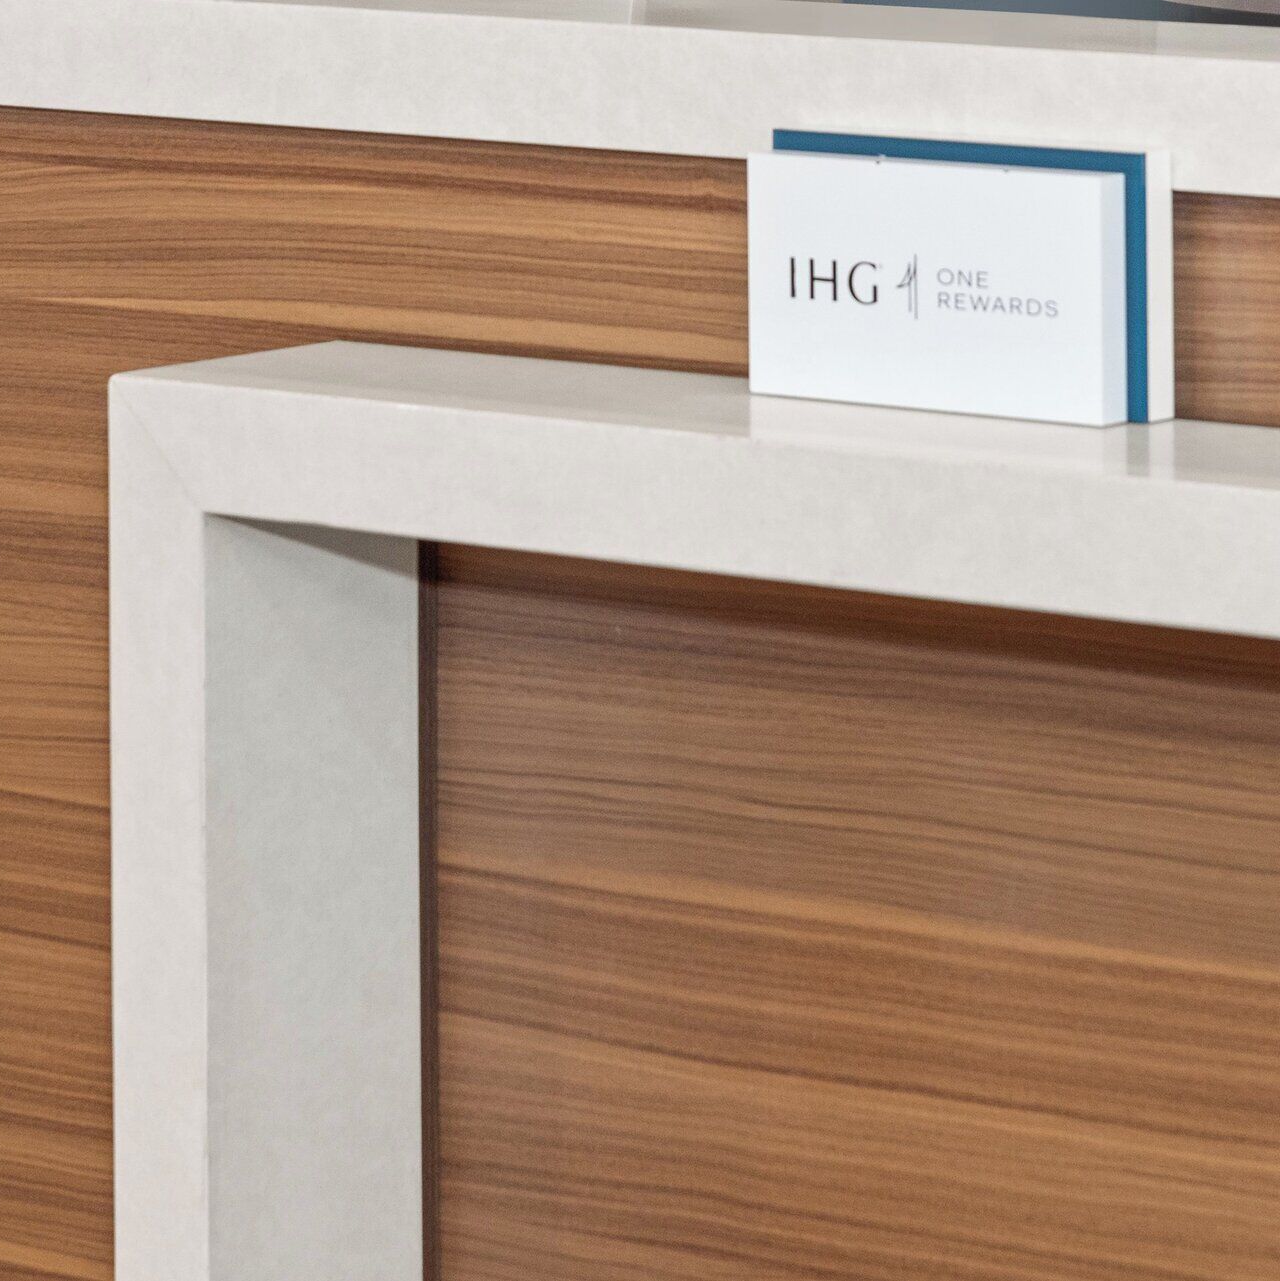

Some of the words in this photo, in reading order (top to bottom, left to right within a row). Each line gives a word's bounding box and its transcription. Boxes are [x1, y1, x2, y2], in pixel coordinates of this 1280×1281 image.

[789, 256, 879, 305] IHG
[936, 267, 990, 288] ONE
[936, 292, 1060, 319] REWARDS
